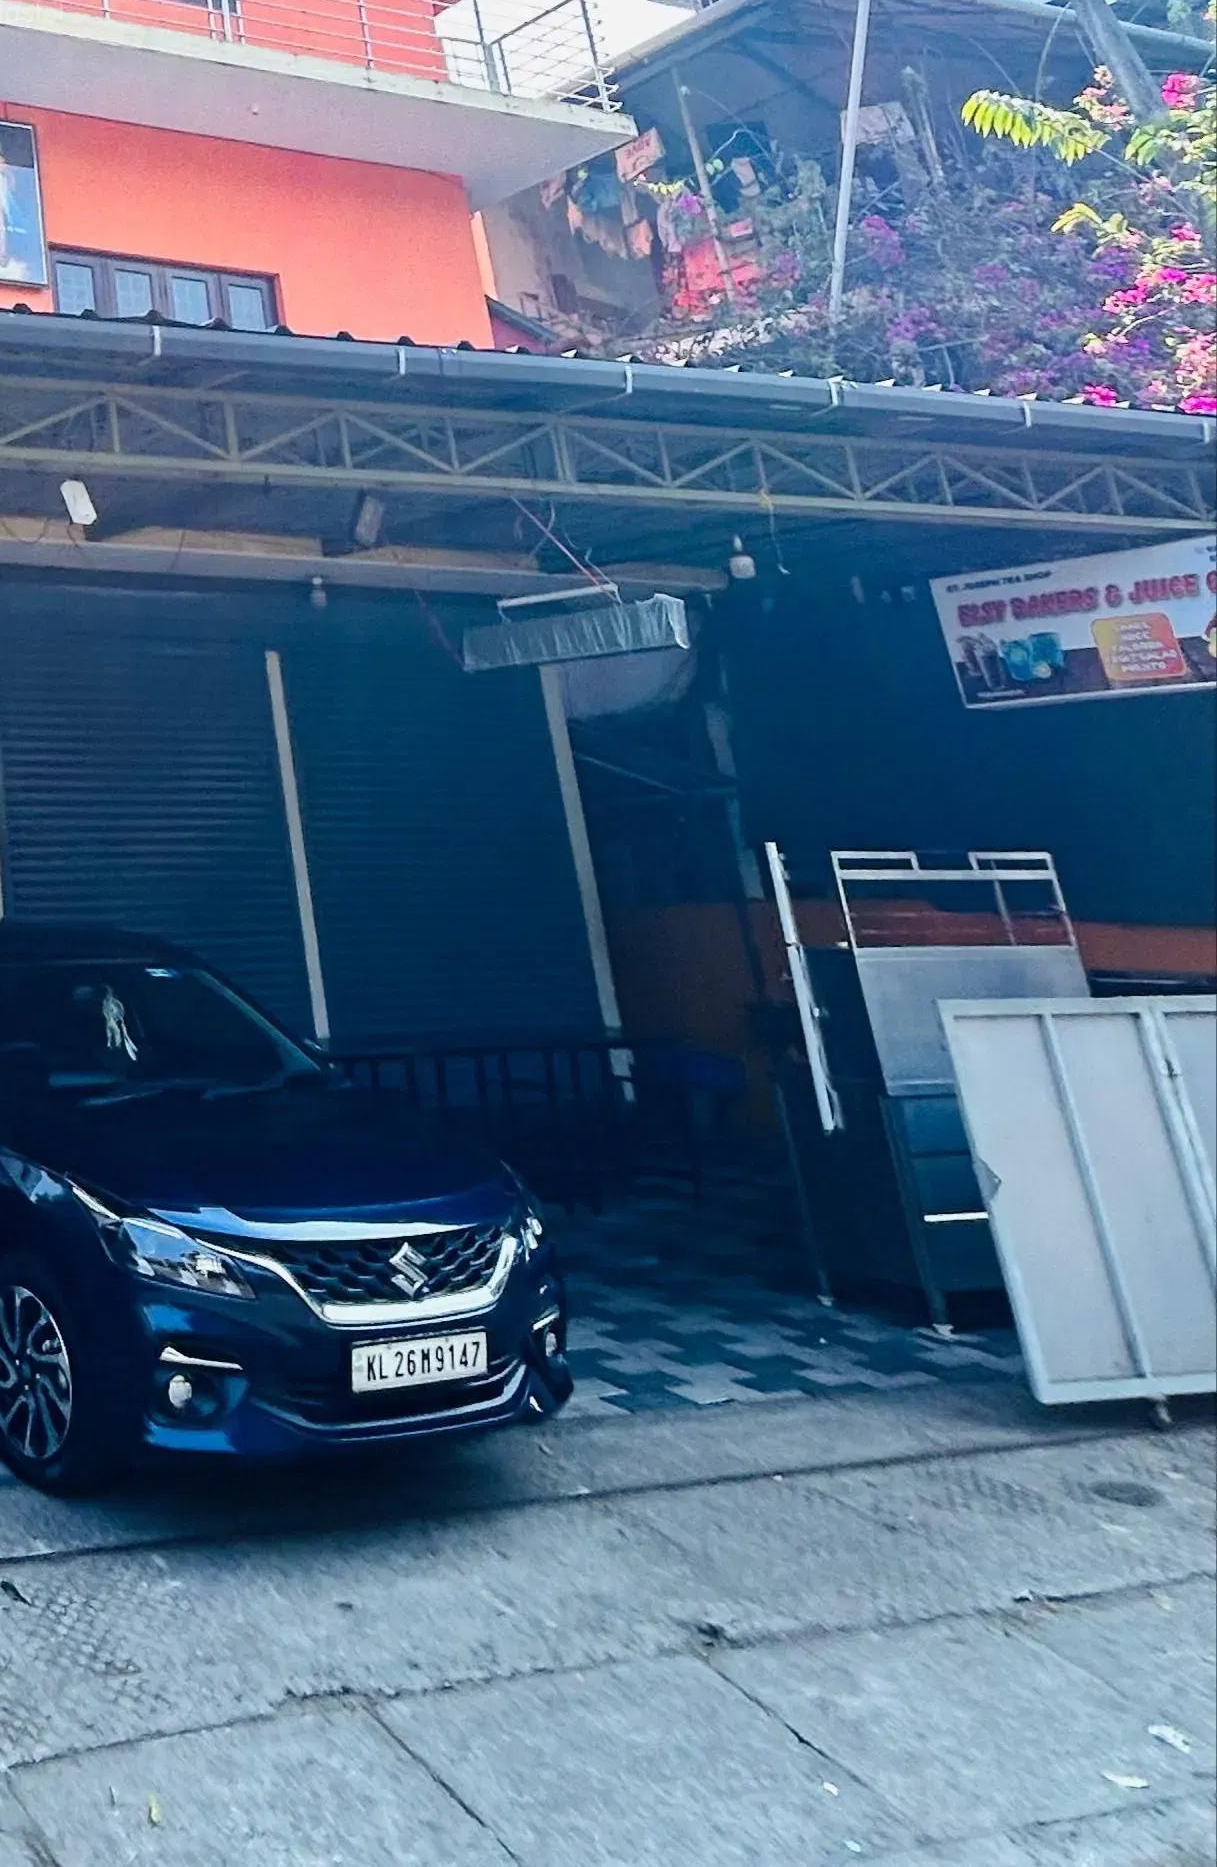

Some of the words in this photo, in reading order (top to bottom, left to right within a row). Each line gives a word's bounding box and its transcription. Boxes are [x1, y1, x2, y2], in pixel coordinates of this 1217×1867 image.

[1010, 586, 1099, 621] BAKERS
[1105, 584, 1122, 609] &
[1128, 573, 1200, 605] JUICE
